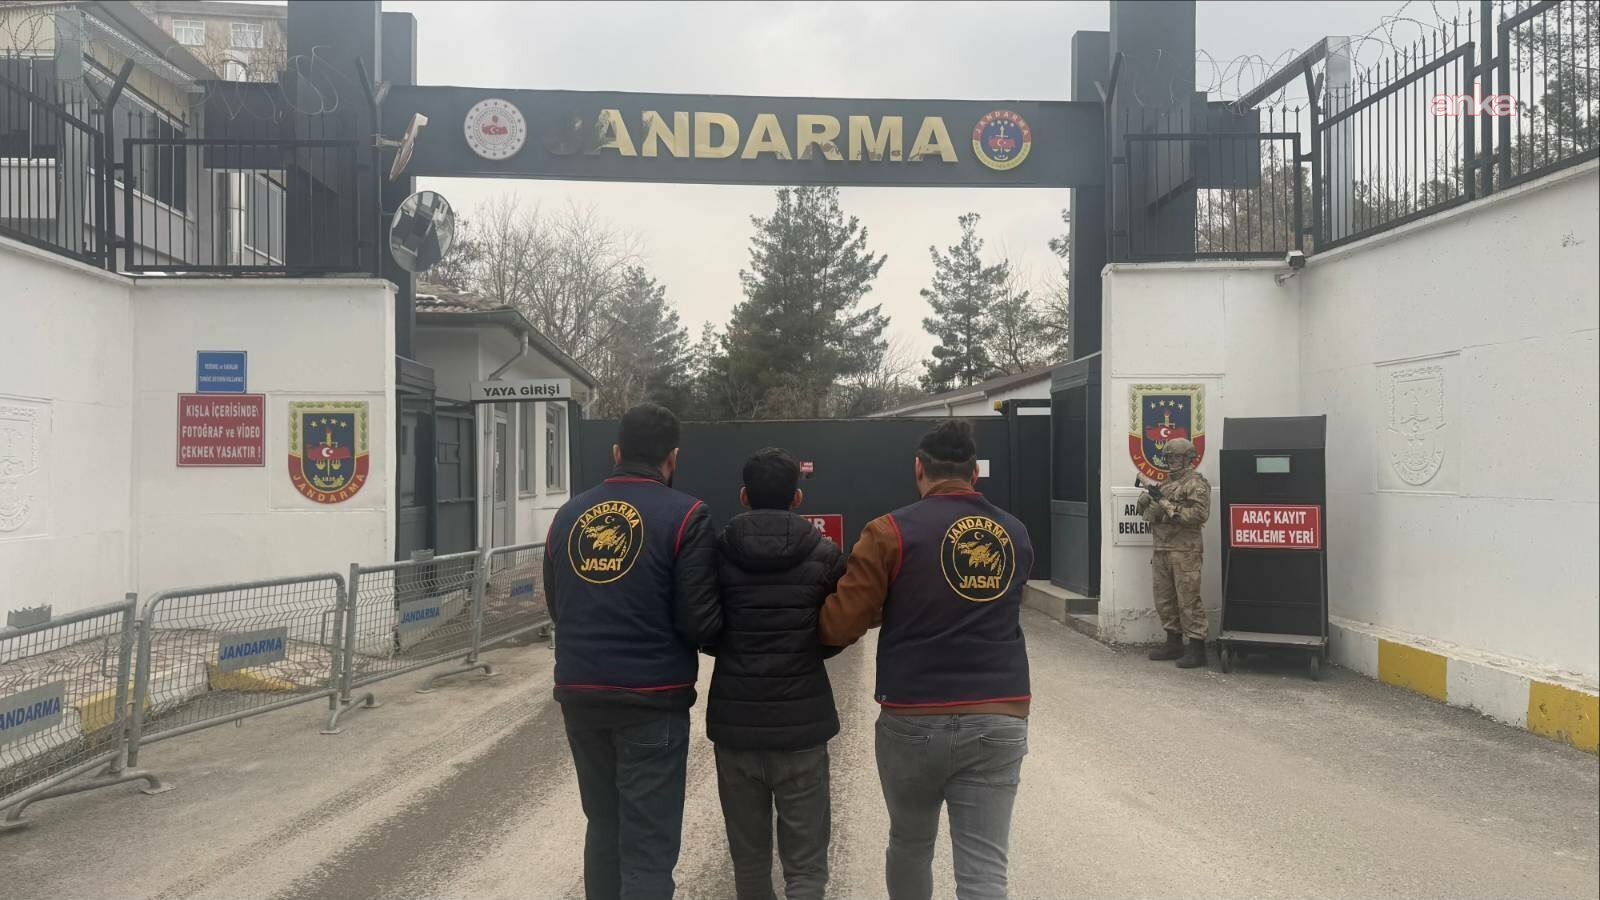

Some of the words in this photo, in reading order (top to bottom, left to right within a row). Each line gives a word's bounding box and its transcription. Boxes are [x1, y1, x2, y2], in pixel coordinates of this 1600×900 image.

[975, 111, 1029, 136] JANDARMA
[483, 387, 516, 397] YAYA
[520, 384, 560, 396] GİRİŞİ
[186, 404, 210, 419] KIŞLA
[211, 402, 258, 418] İÇERİSİNDE
[181, 424, 224, 438] FOTOĞRAF
[226, 430, 237, 438] ve
[237, 424, 261, 438] VİDEO
[181, 446, 215, 459] ÇEKMEK
[216, 446, 256, 458] YASAKTIR
[293, 474, 365, 502] JANDARMA
[580, 503, 640, 528] JANDARMA
[1242, 510, 1271, 527] ARAÇ
[1274, 511, 1306, 524] KAYIT
[948, 518, 1009, 546] JANDARMA
[1236, 529, 1285, 543] BEKLEME
[1289, 528, 1313, 543] YERİ
[581, 558, 623, 571] JASAT
[960, 575, 1001, 589] JASAT
[221, 637, 282, 660] JANDARMA
